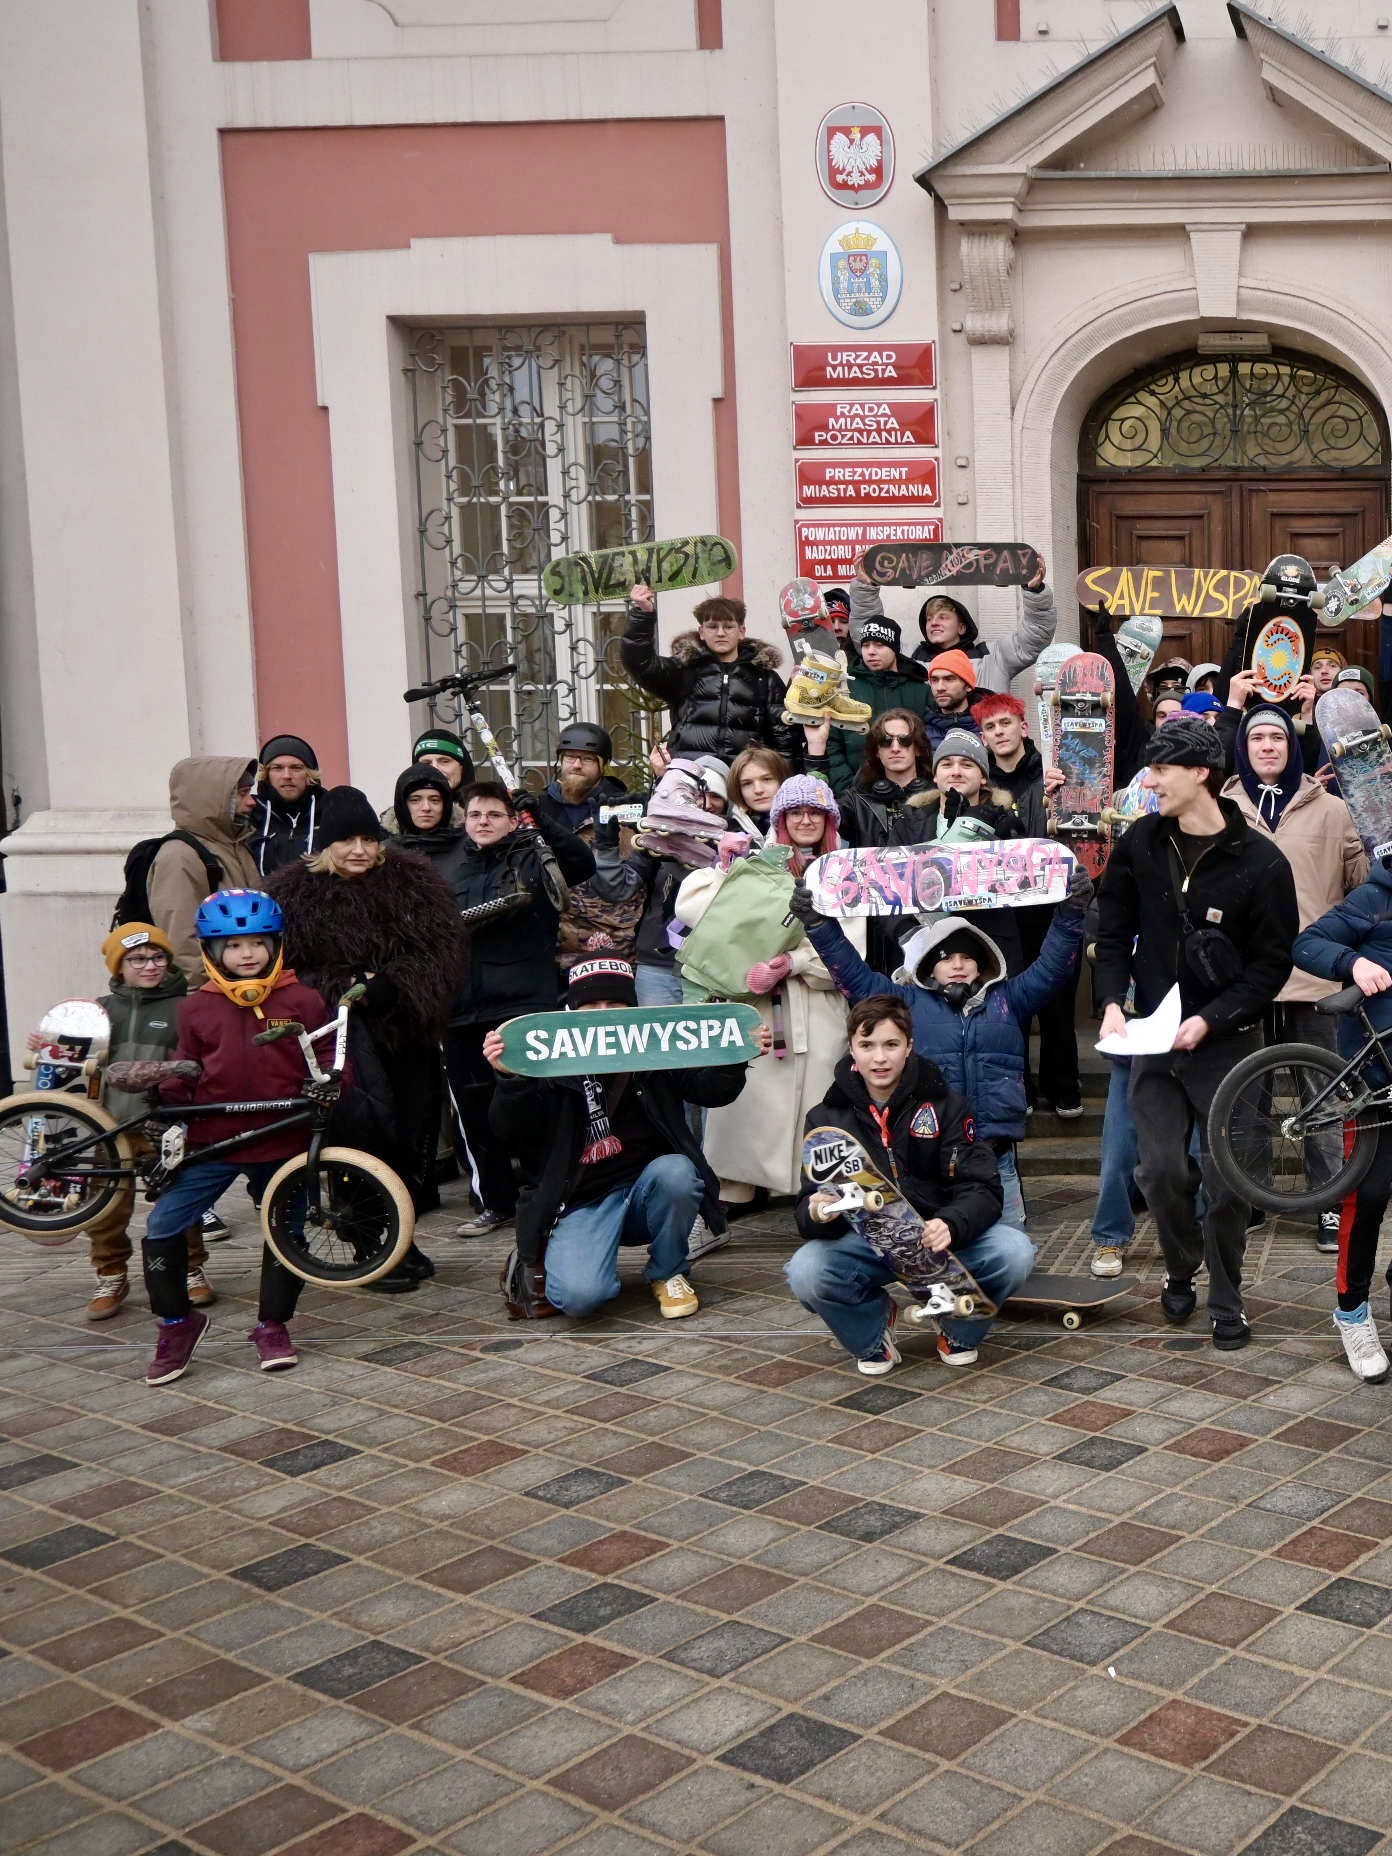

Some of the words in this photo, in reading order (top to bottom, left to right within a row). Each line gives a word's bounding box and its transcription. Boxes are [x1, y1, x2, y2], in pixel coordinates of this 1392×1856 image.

[827, 351, 896, 366] URZĄD
[826, 365, 898, 379] MIASTA
[836, 403, 891, 416] RADA
[828, 417, 900, 430] MIASTA
[814, 430, 915, 444] POZNANIA
[825, 467, 908, 480] PREZYDENT
[803, 485, 855, 498] MIASTA
[860, 484, 932, 497] POZNANIA
[802, 527, 863, 541] POWIATOWY
[866, 525, 935, 540] INSPEKTORAT
[805, 545, 851, 560] NADZORU
[815, 564, 832, 577] DLA
[838, 564, 857, 576] MIA
[1084, 567, 1164, 615] SAVE
[525, 1017, 745, 1061] SAVEWYSPA
[814, 1142, 846, 1167] NIKE
[844, 1158, 861, 1174] SB
